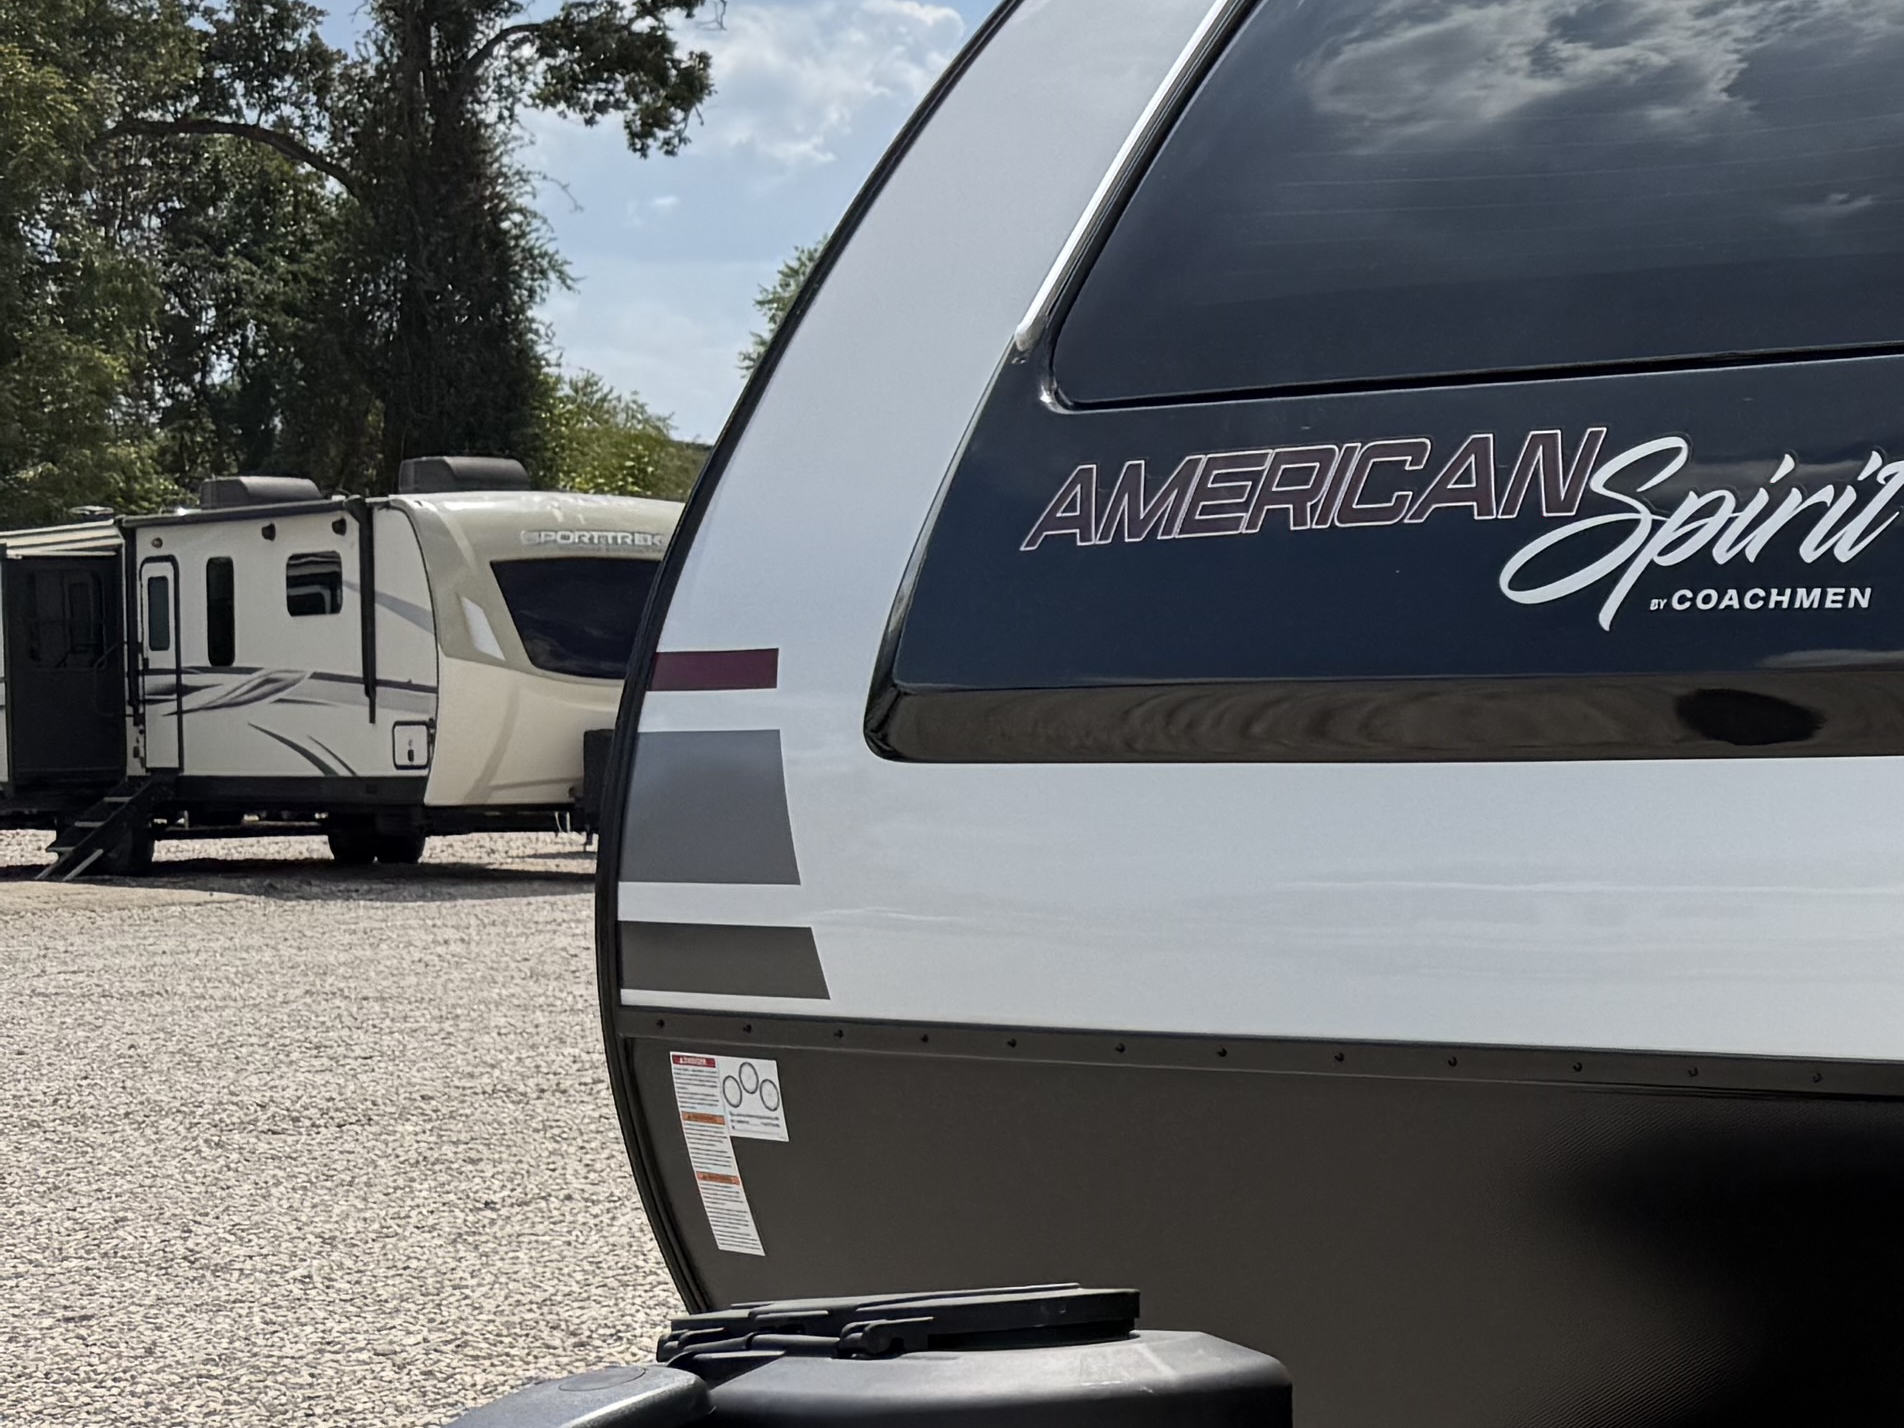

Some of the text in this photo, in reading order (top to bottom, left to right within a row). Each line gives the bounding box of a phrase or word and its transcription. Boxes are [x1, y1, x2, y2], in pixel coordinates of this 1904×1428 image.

[1020, 427, 1607, 551] AMERICAN
[1649, 587, 1872, 611] BY COACHMEN
